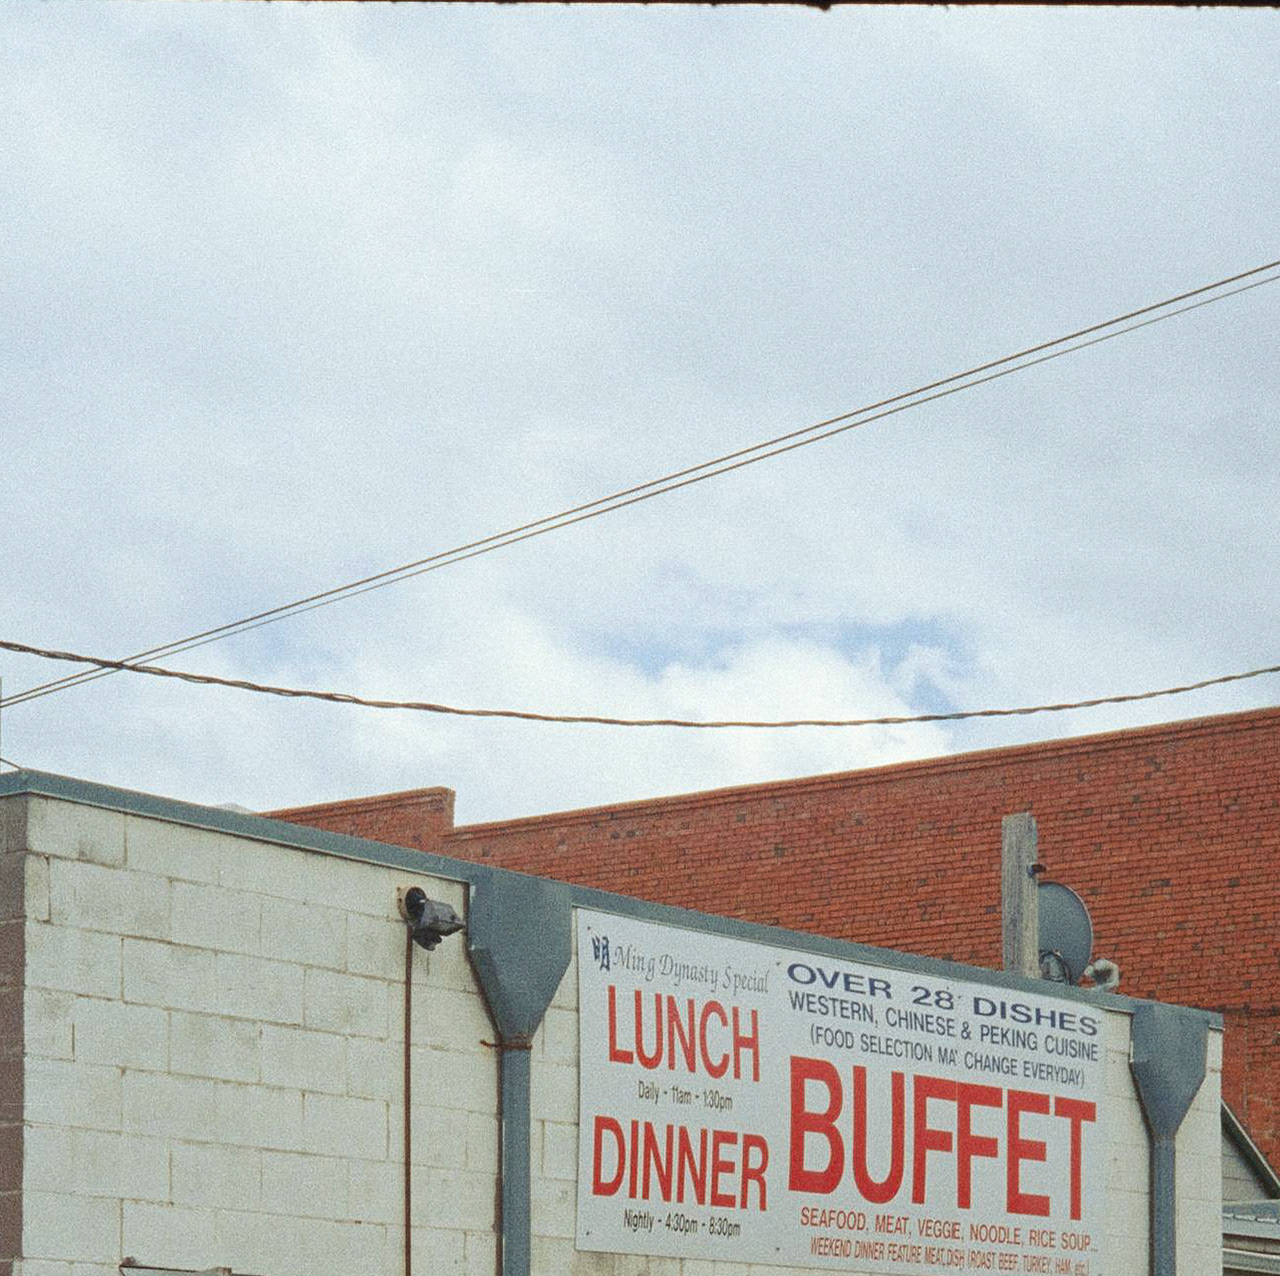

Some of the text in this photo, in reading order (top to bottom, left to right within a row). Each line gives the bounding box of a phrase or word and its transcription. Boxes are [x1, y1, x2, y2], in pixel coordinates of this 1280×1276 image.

[612, 944, 770, 996] Ming Dynasty Special
[787, 963, 1098, 1036] OVER 28 DISHES
[608, 985, 760, 1082] LUNCH
[788, 990, 1099, 1062] WESTERN, CHINESE & PEKING CUISINE
[810, 1023, 855, 1049] (FOOD
[860, 1033, 933, 1062] SELECTION
[964, 1051, 1018, 1076] CHANGE
[1023, 1061, 1085, 1089] EVERYDAY)
[638, 1080, 660, 1105] Daily
[671, 1085, 692, 1104] 11am
[703, 1089, 733, 1112] 1:30pm
[593, 1115, 769, 1211] DINNER
[788, 1055, 1097, 1221] BUFFET
[624, 1209, 654, 1233] Nightly
[665, 1212, 698, 1234] 4:30pm
[708, 1216, 741, 1238] 8:30pm
[810, 1236, 852, 1258] WEEKEND
[855, 1240, 884, 1261] DINNER
[888, 1242, 922, 1264] FEATURE
[875, 1214, 912, 1239] MEAT,
[1029, 1229, 1056, 1248] RICE
